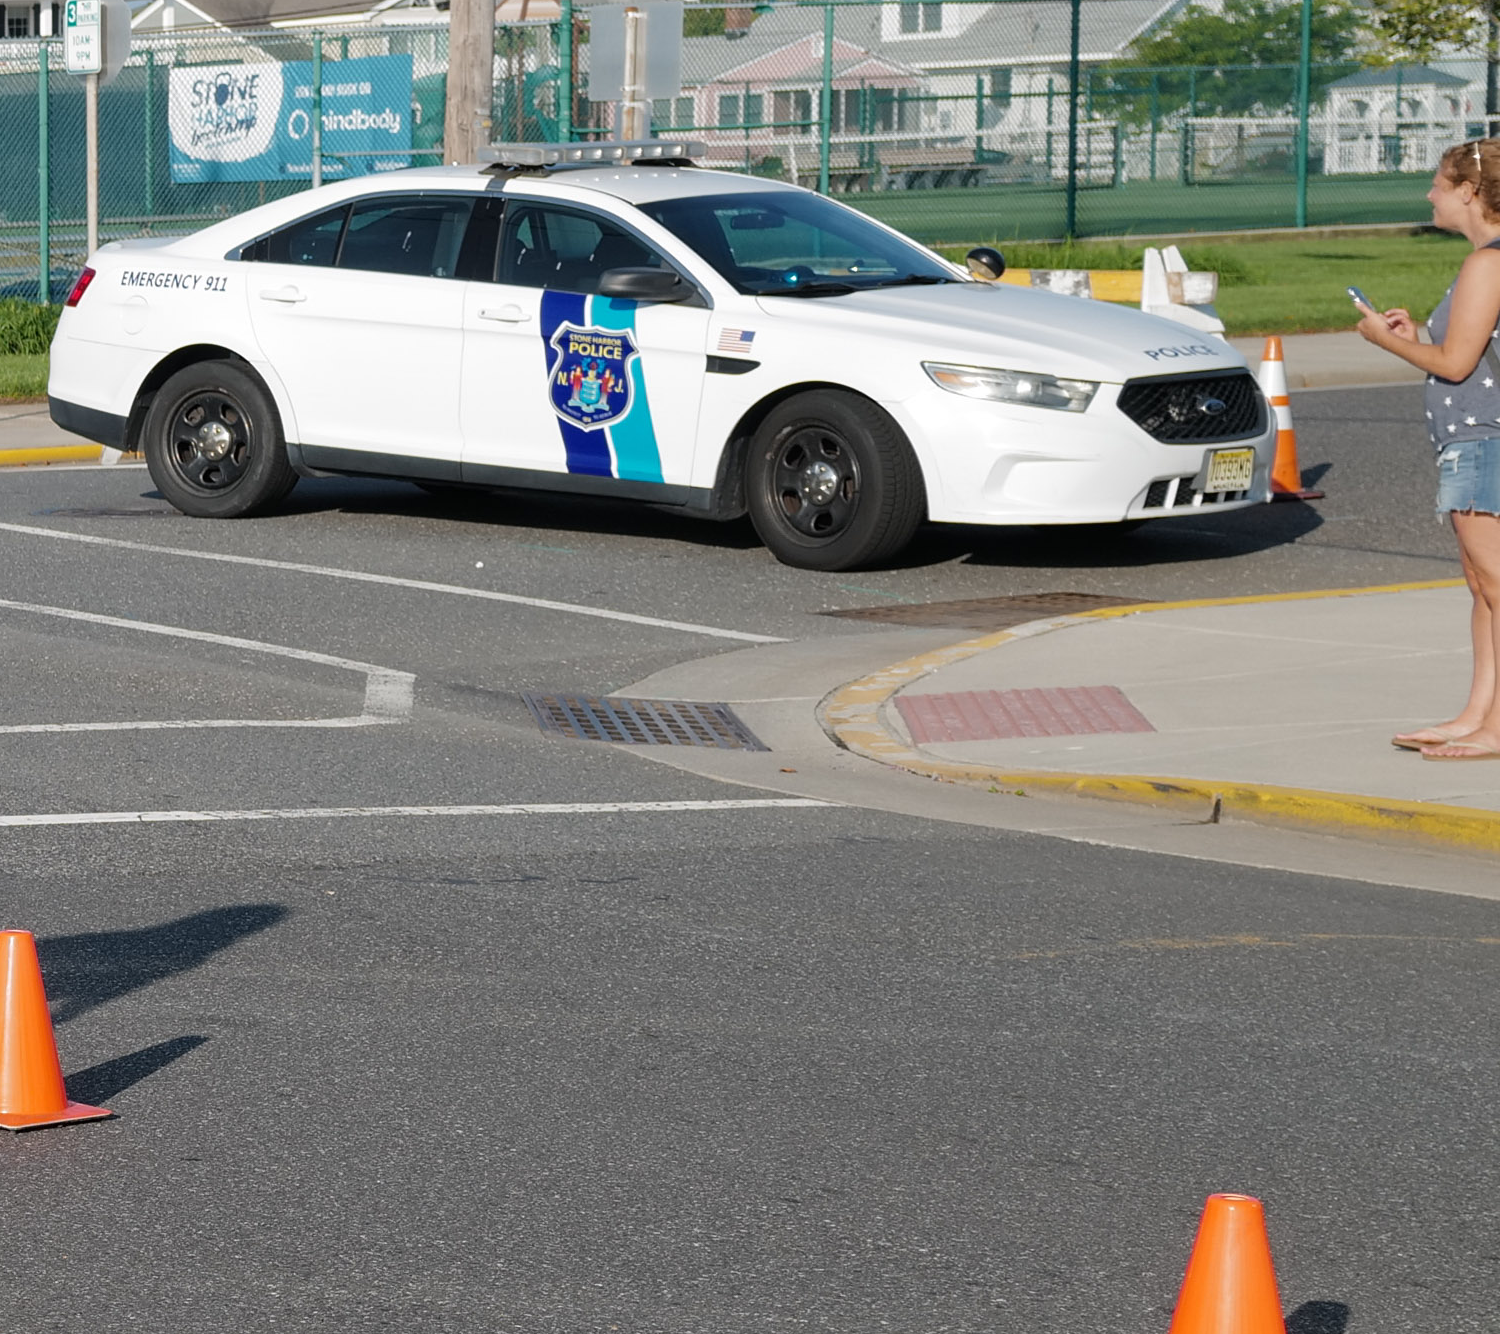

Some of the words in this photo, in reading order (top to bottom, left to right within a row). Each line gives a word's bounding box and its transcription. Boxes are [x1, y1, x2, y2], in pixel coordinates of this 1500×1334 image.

[68, 4, 76, 23] 3
[121, 271, 202, 290] EMERGENCY
[204, 275, 228, 292] 911
[569, 334, 592, 344] STONE
[593, 336, 622, 347] HARBOR
[569, 342, 622, 360] POLICE
[1144, 345, 1219, 361] POLICE
